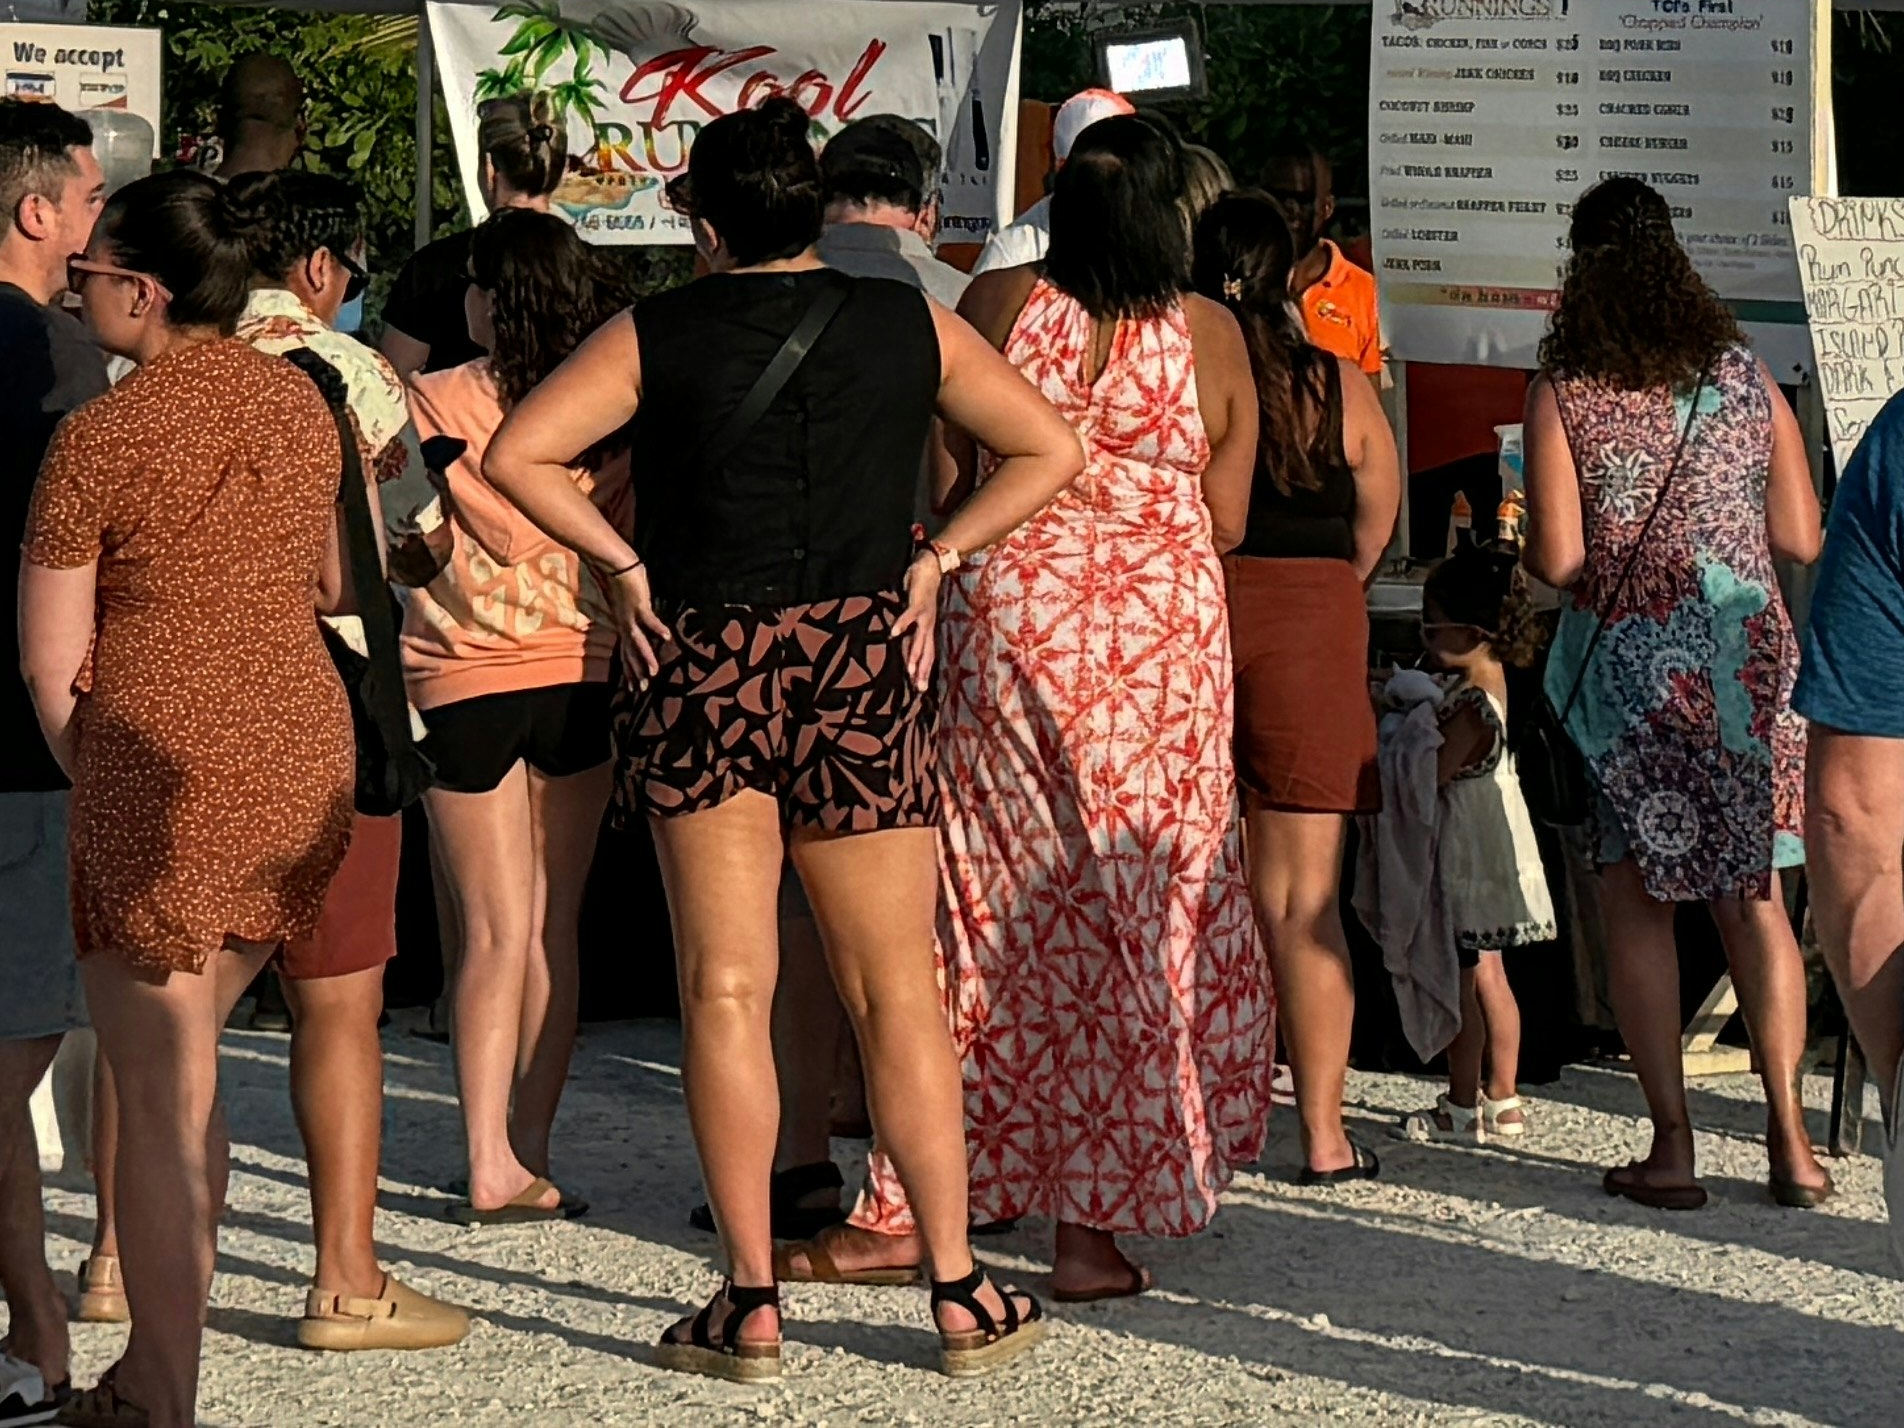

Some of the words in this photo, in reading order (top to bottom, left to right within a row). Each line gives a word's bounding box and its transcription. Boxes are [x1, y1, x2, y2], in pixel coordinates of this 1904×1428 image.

[13, 42, 47, 63] We
[55, 48, 125, 72] accept
[620, 38, 886, 131] Kool
[1800, 244, 1851, 281] Rum
